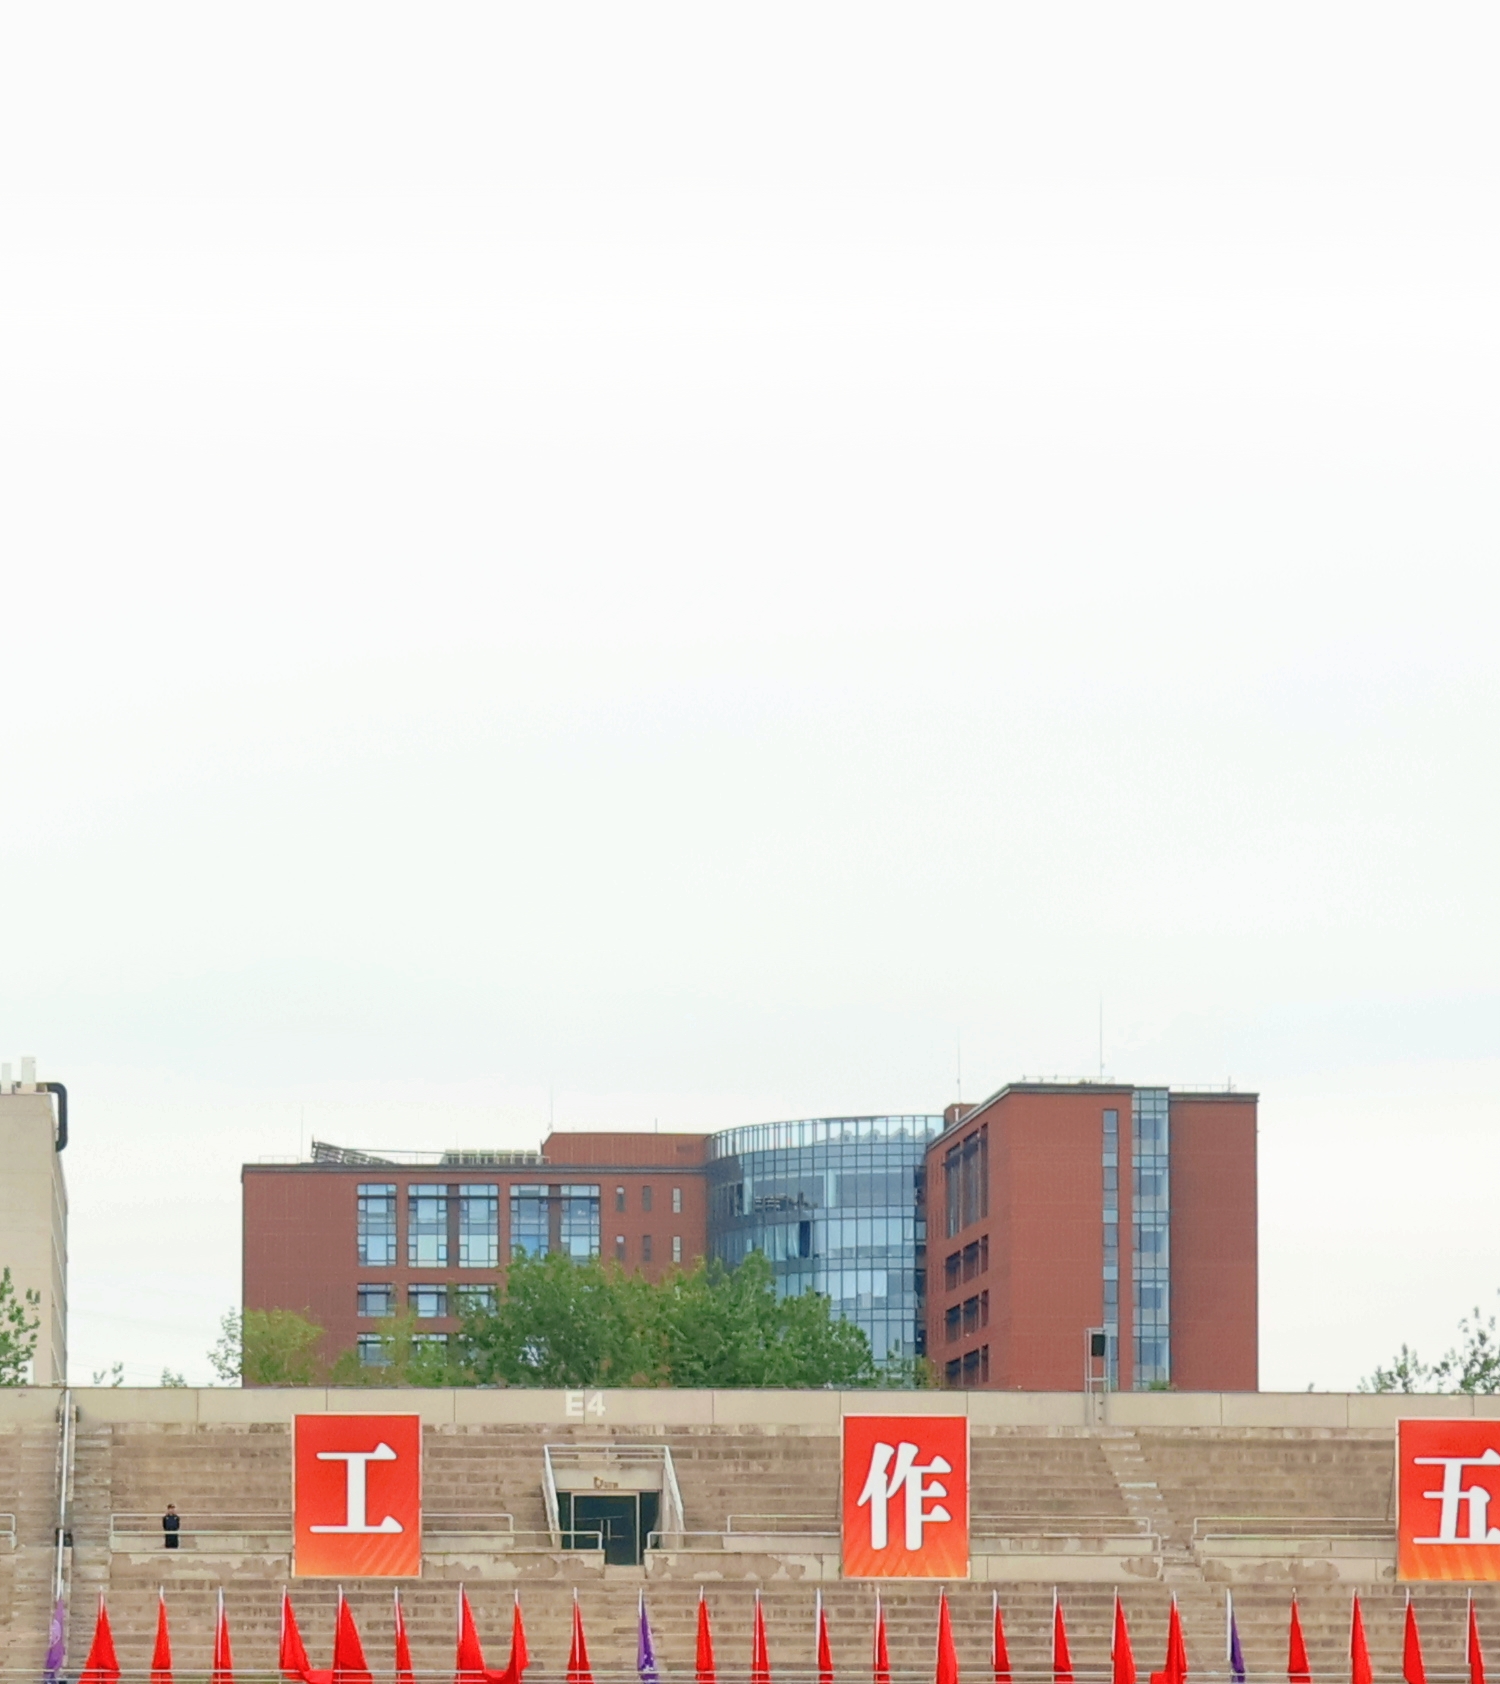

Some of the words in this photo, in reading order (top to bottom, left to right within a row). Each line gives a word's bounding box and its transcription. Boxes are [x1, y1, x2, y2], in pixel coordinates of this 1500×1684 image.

[564, 1391, 606, 1416] E4
[310, 1443, 402, 1533] 工
[858, 1443, 951, 1551] 作
